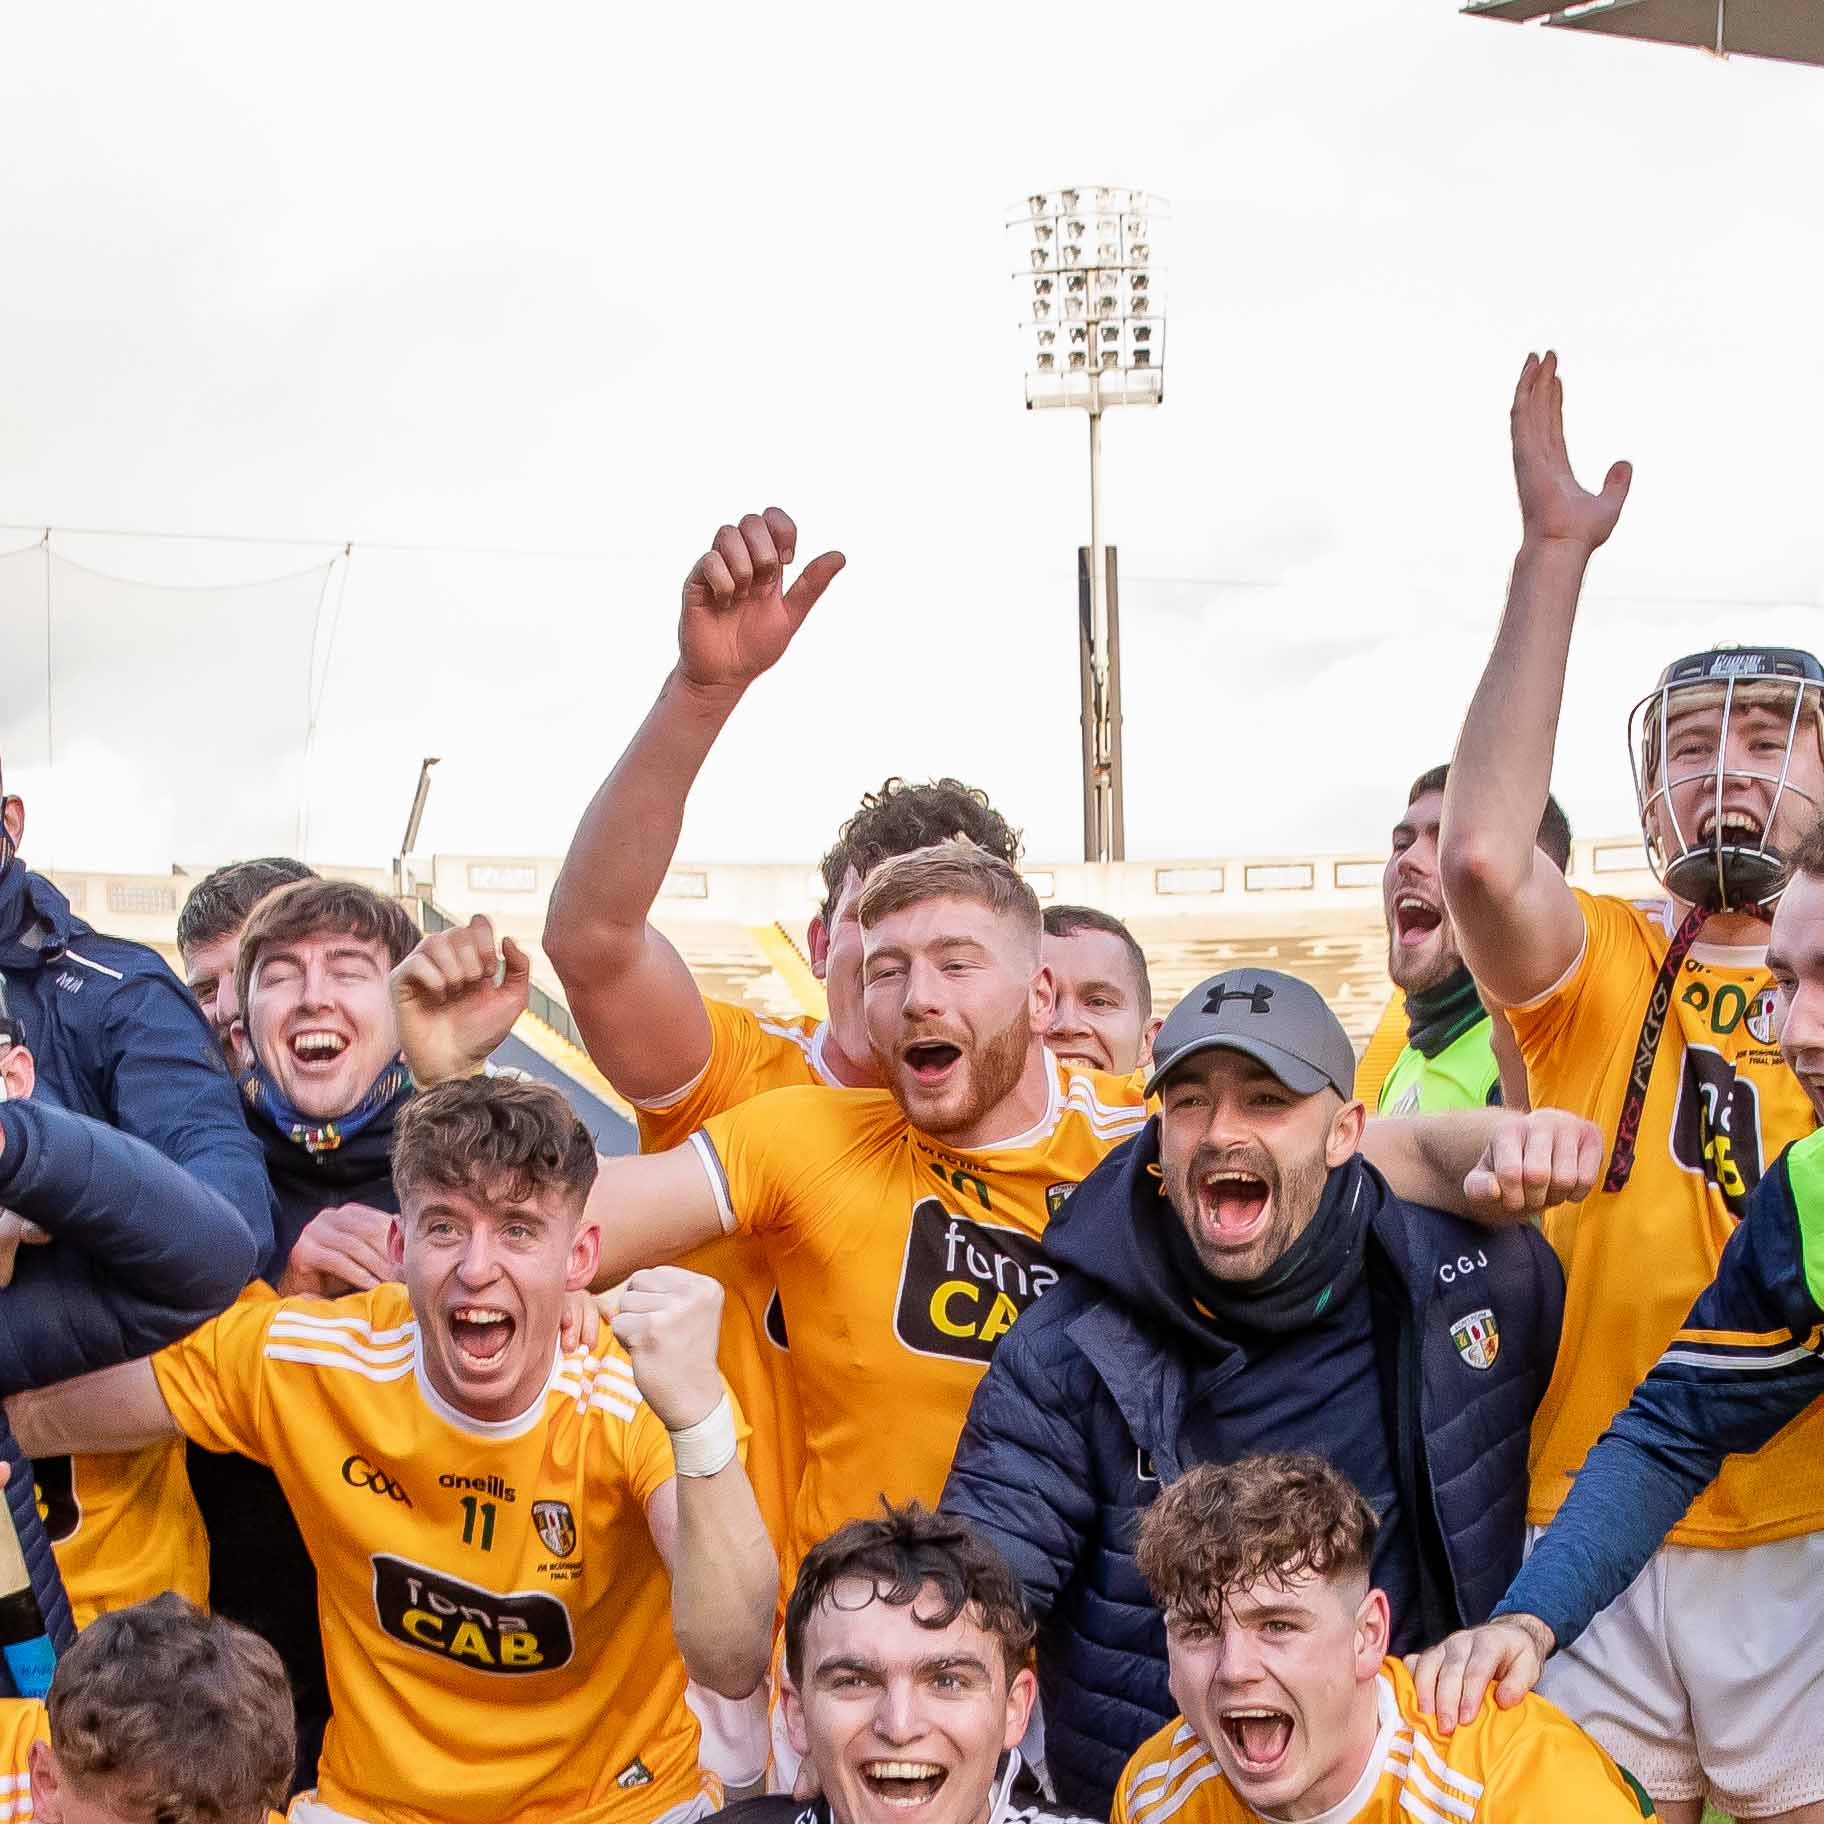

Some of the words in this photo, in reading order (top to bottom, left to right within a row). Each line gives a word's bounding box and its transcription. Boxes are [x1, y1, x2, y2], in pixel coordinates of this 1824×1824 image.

[929, 1279, 1021, 1342] CA
[459, 1495, 497, 1553] 11
[402, 1607, 544, 1666] CAB
